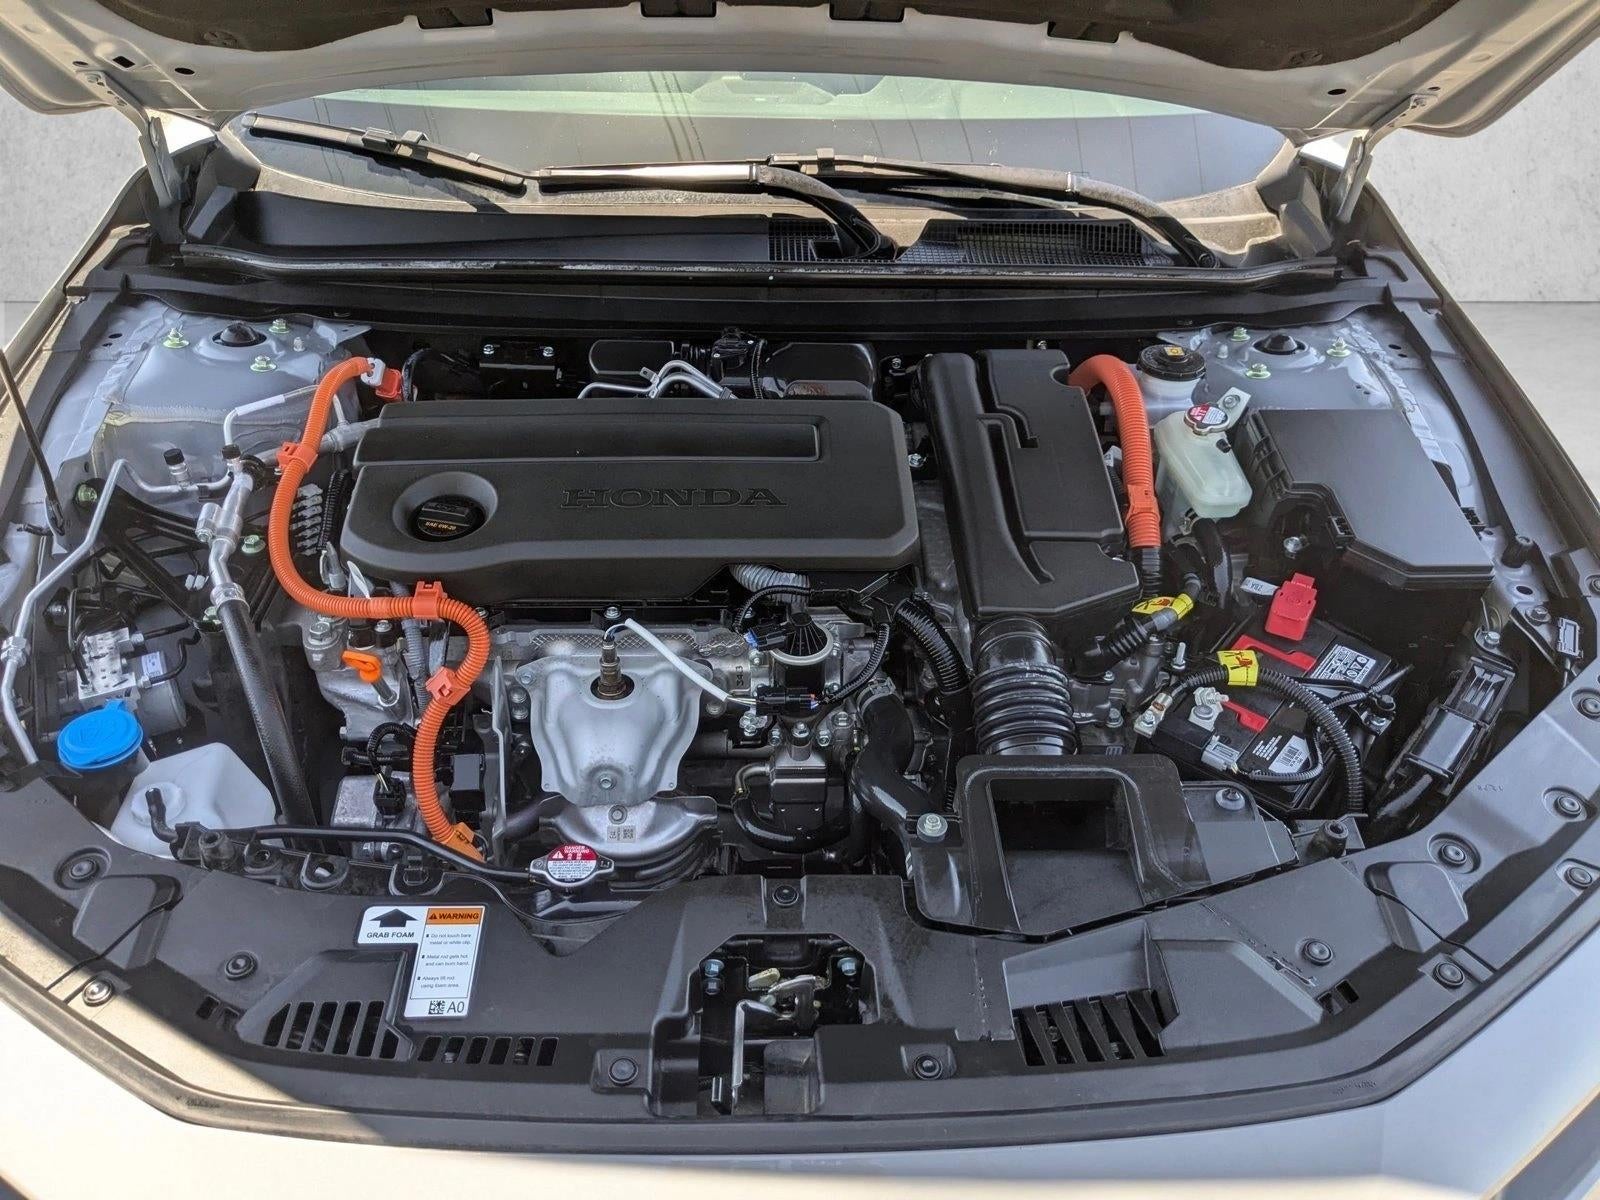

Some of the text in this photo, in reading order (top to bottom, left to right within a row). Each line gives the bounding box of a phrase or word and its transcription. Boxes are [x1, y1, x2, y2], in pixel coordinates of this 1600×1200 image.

[560, 487, 788, 509] HONDA
[438, 523, 457, 531] 0W-20
[438, 911, 480, 920] WARNING
[366, 931, 389, 939] GRAB
[446, 1000, 465, 1014] A0
